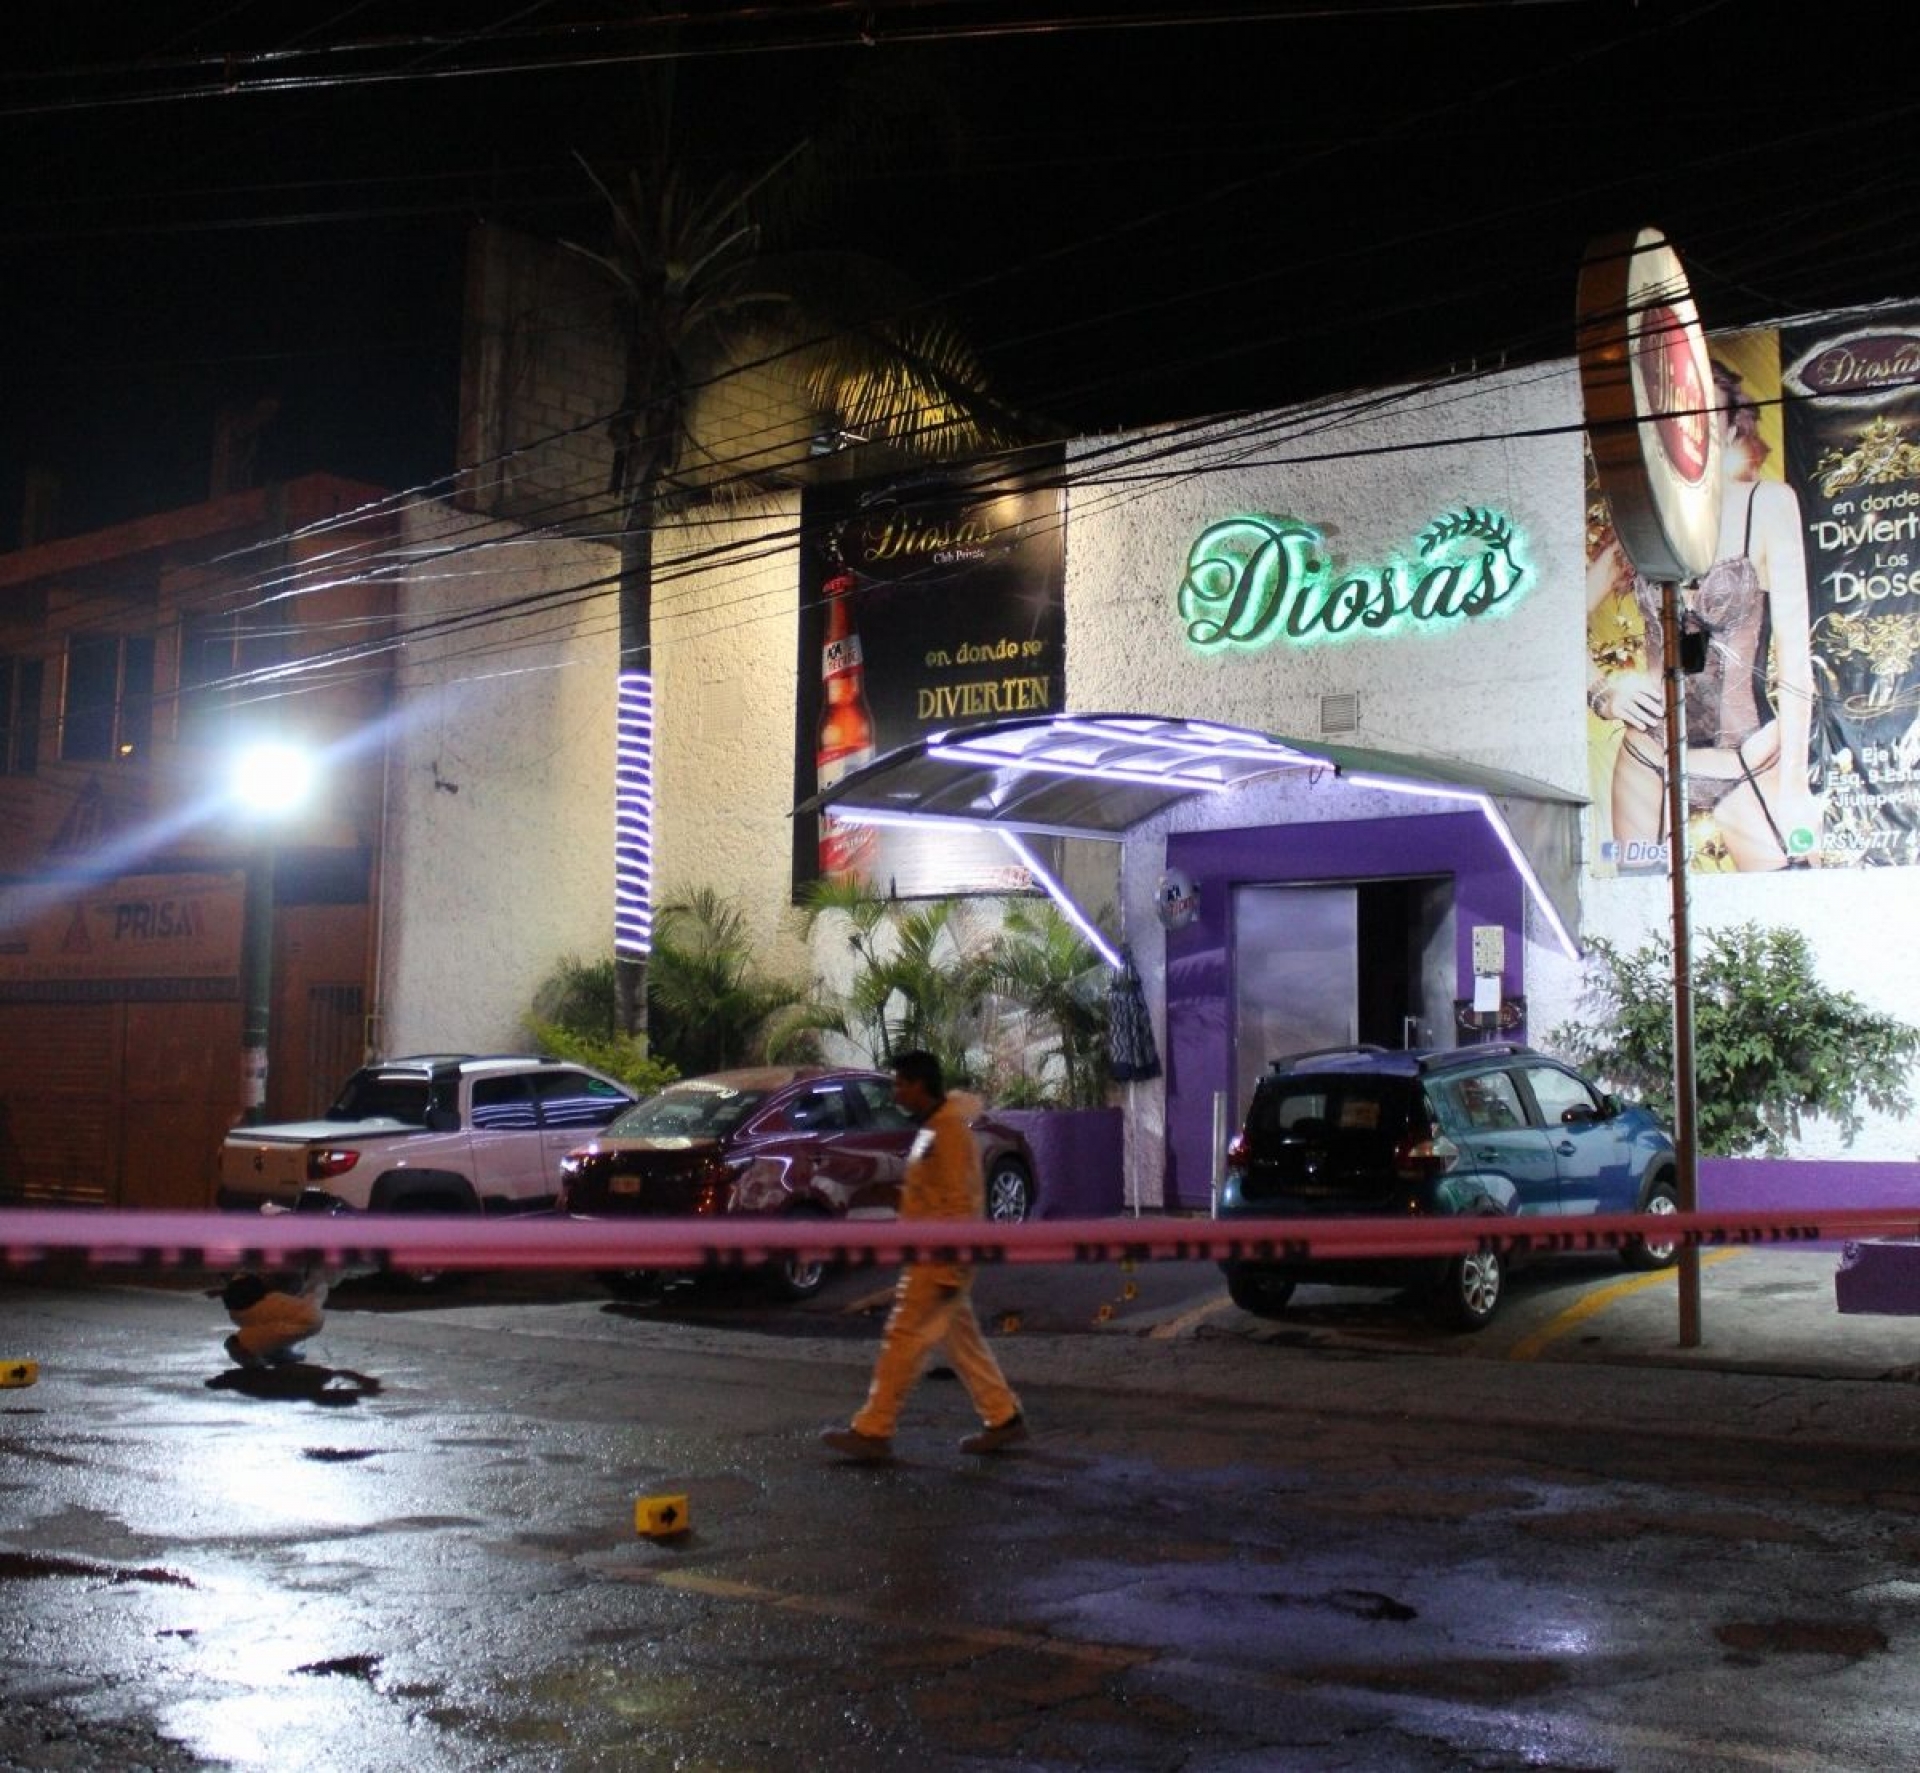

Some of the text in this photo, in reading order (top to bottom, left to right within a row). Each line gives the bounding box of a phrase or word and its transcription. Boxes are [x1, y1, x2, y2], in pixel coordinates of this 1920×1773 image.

[1818, 347, 1920, 385] Diosas
[1832, 490, 1920, 515] en donde
[864, 508, 998, 561] Diosas
[1178, 515, 1523, 644] Diosas
[1875, 553, 1908, 568] Los
[925, 638, 1042, 667] en donde se
[917, 677, 1049, 720] DIVIERTEN
